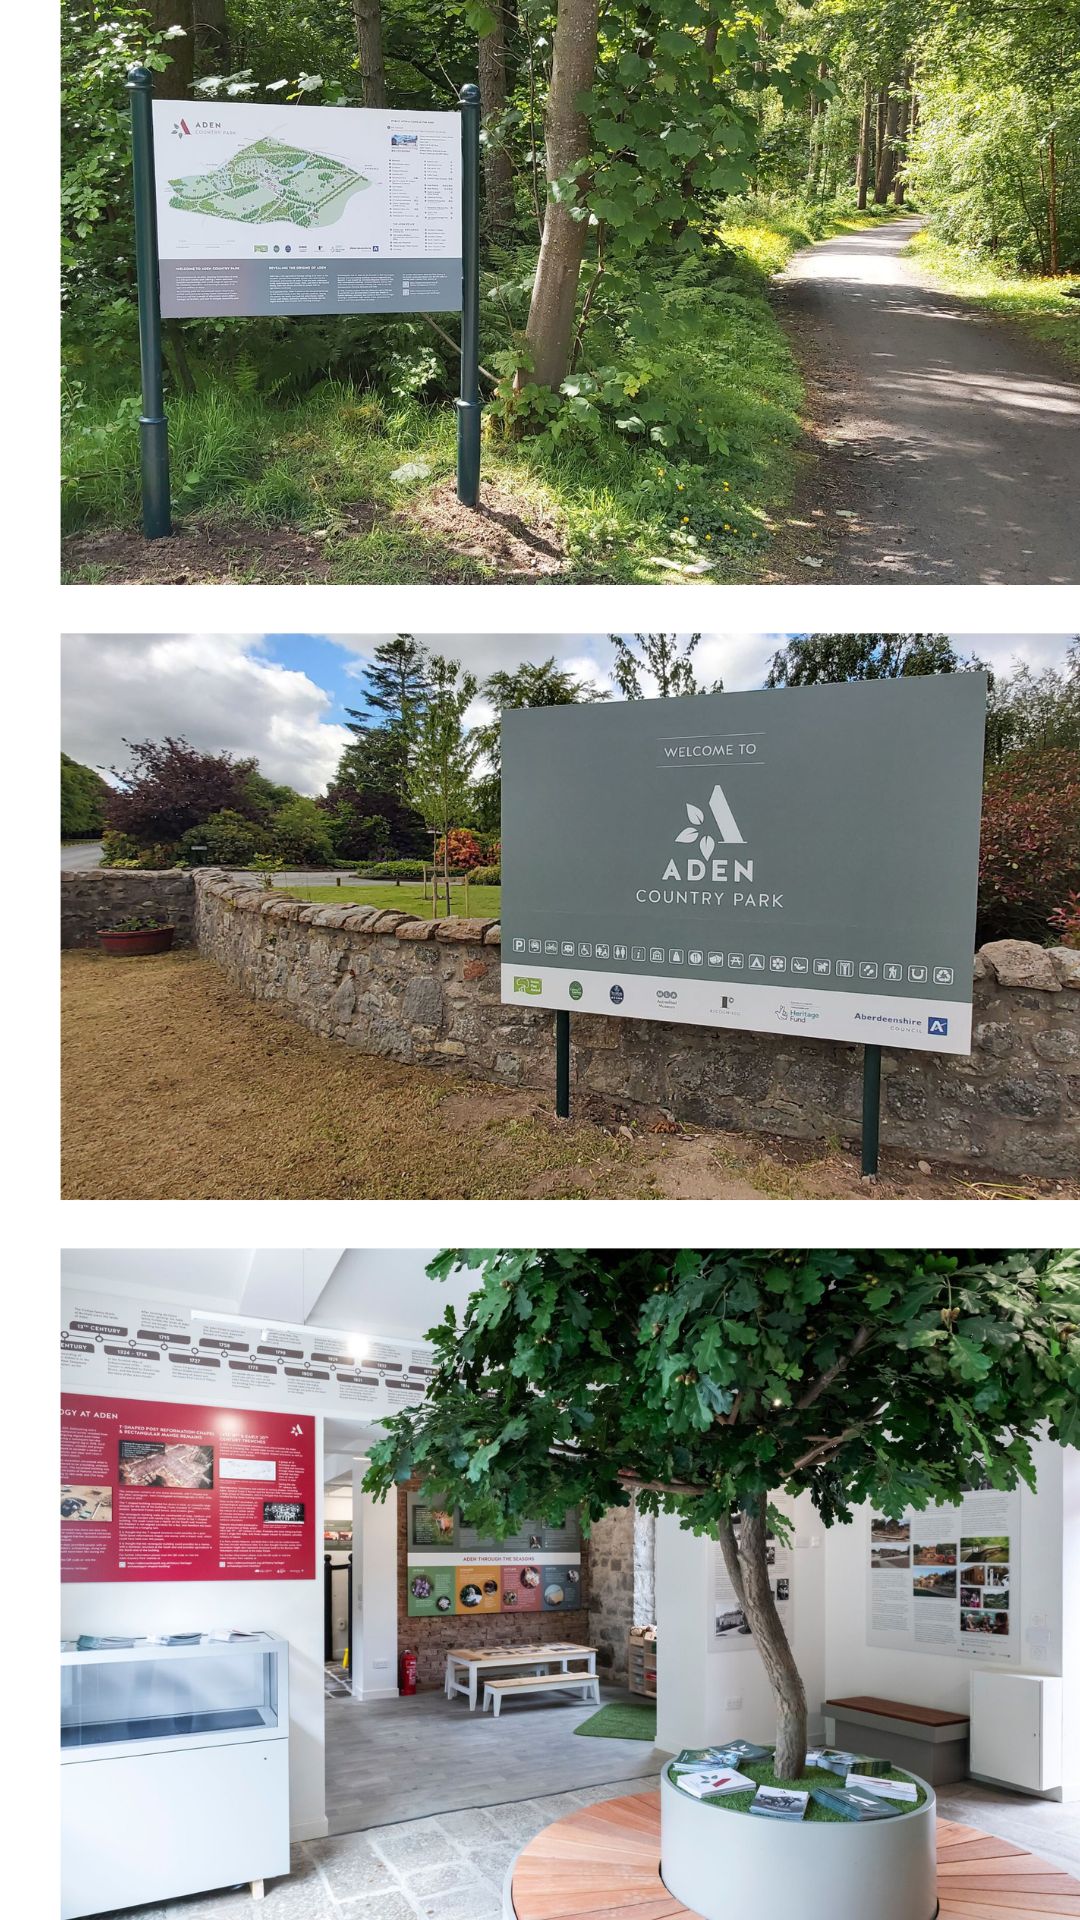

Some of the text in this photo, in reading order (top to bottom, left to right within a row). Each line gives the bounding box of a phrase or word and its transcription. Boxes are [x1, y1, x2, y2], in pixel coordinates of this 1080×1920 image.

[664, 743, 757, 758] WELCOME TO
[661, 858, 754, 882] ADEN
[636, 889, 784, 908] COUNTRY PARK
[790, 1009, 820, 1019] Heritage
[854, 1012, 922, 1026] Aberdeenshire
[790, 1016, 806, 1024] Fund
[889, 1026, 923, 1034] COUNCIL
[90, 1325, 121, 1334] CENTURY
[93, 1412, 118, 1420] ADEN
